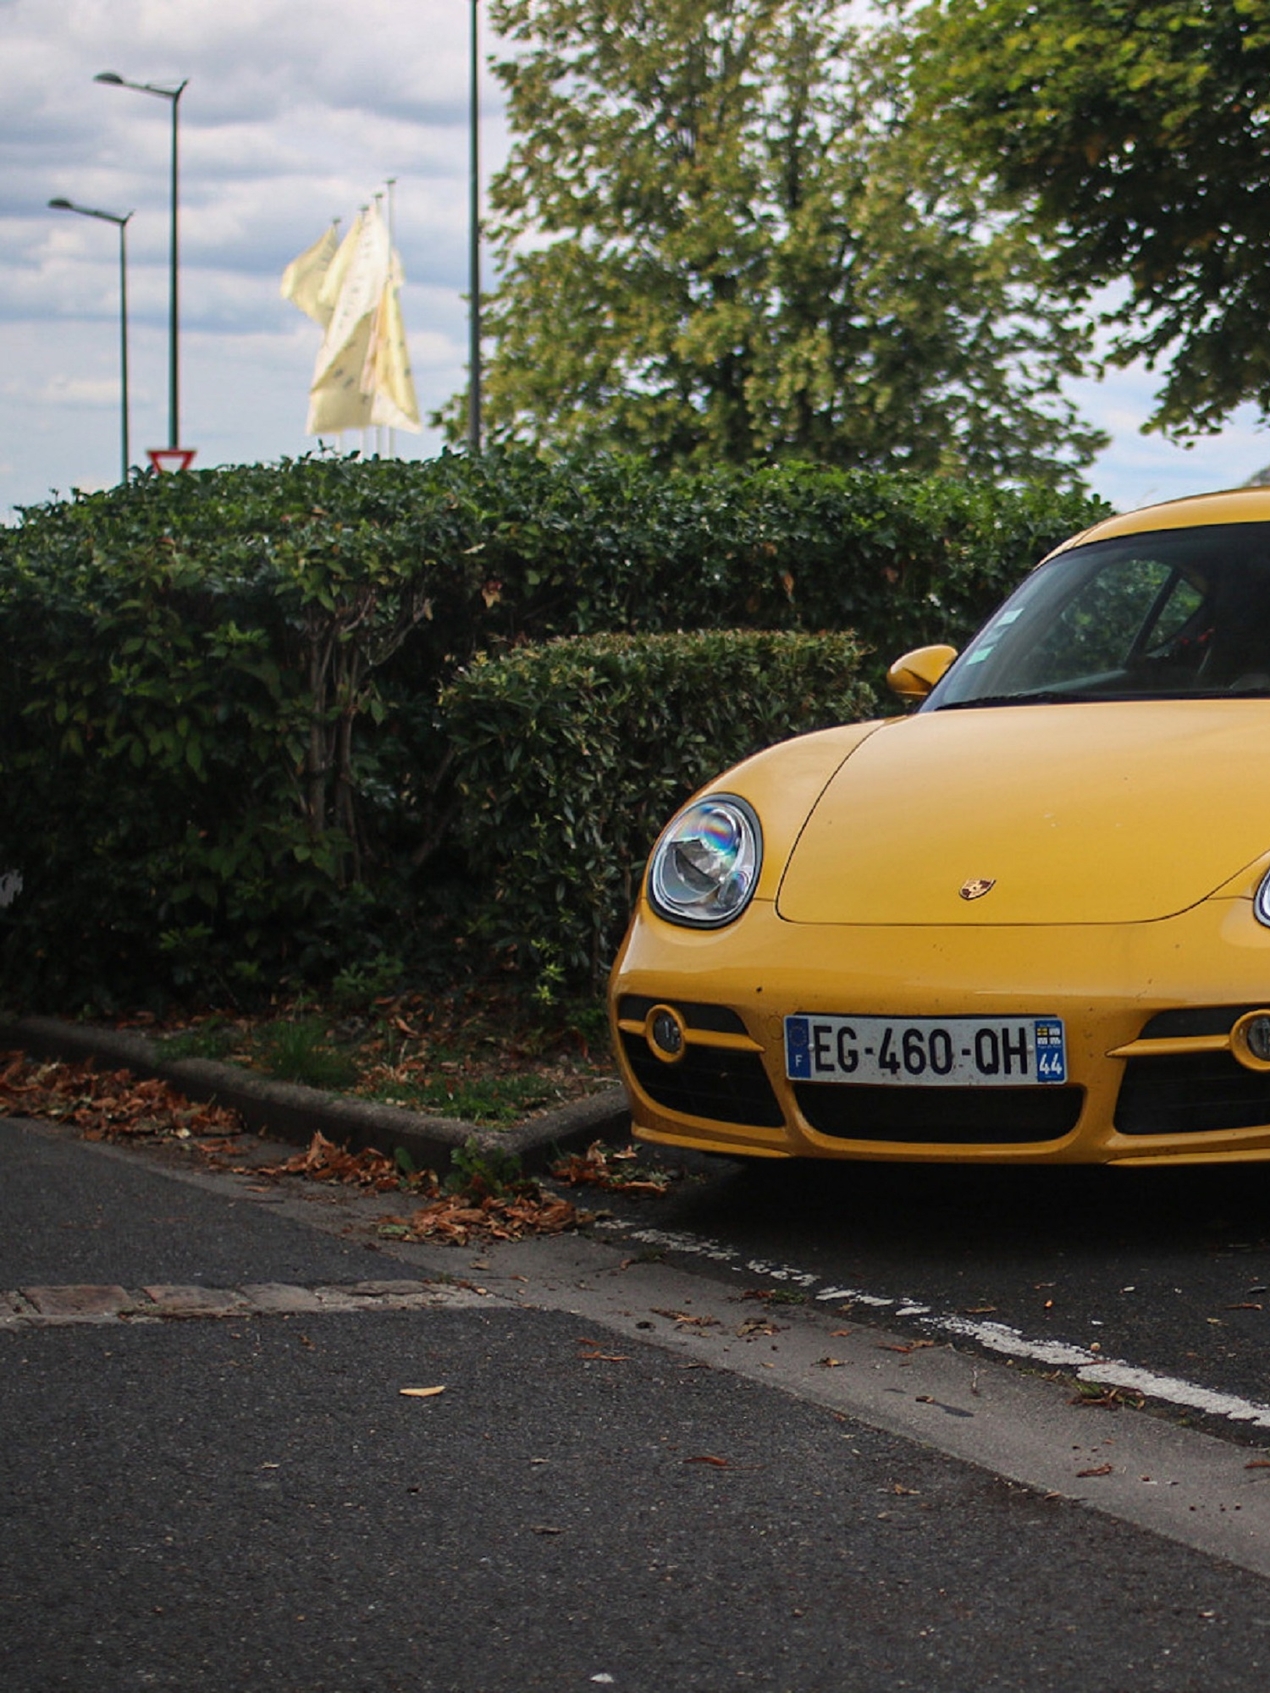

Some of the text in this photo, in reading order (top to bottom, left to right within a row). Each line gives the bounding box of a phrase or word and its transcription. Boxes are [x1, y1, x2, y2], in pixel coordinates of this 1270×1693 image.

[795, 1054, 803, 1067] F
[813, 1025, 1028, 1075] EG-460-QH
[1039, 1053, 1062, 1075] 44
